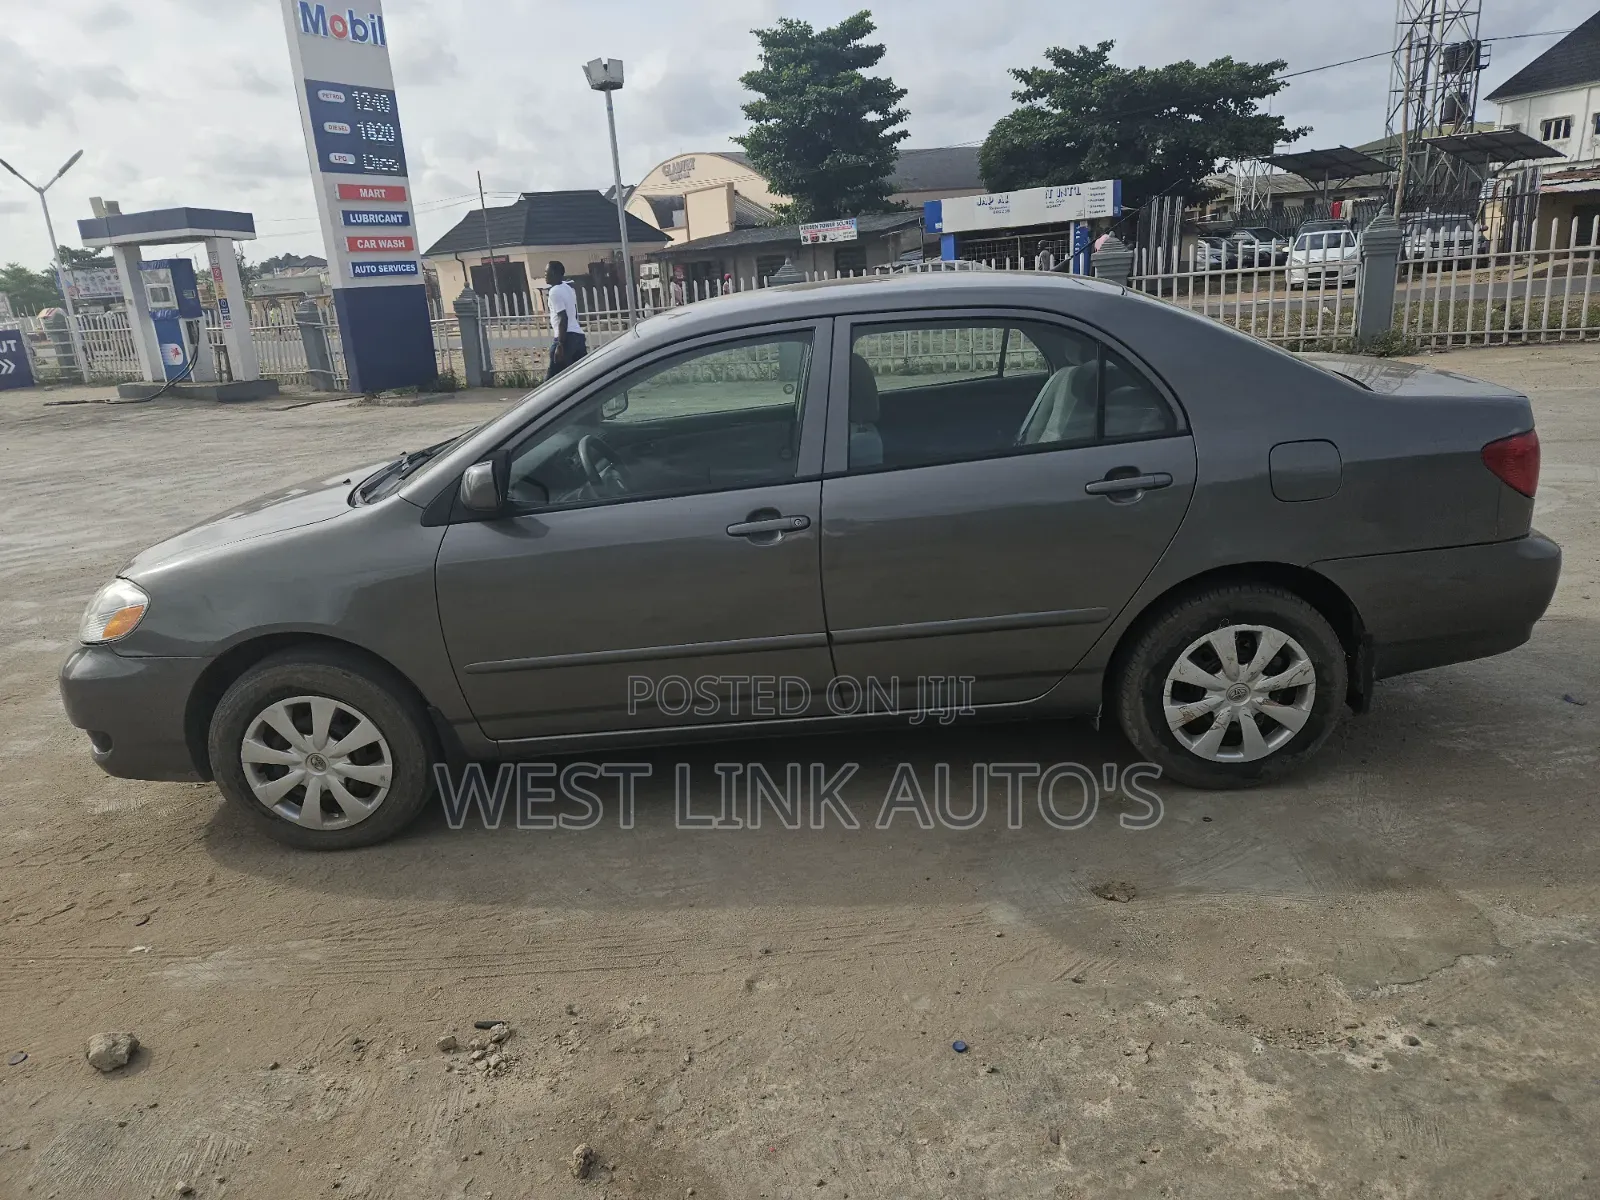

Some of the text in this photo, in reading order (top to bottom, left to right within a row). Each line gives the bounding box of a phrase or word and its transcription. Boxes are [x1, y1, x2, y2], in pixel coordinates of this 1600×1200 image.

[299, 1, 386, 46] Mobil
[322, 92, 343, 100] PETROL
[352, 91, 391, 113] 1240
[328, 124, 349, 132] DIESEL
[334, 154, 347, 162] LPG
[359, 188, 386, 198] MART
[349, 213, 403, 223] LUBRICANT
[356, 239, 406, 249] CAR WASH
[354, 264, 416, 274] AUTO SERVICES
